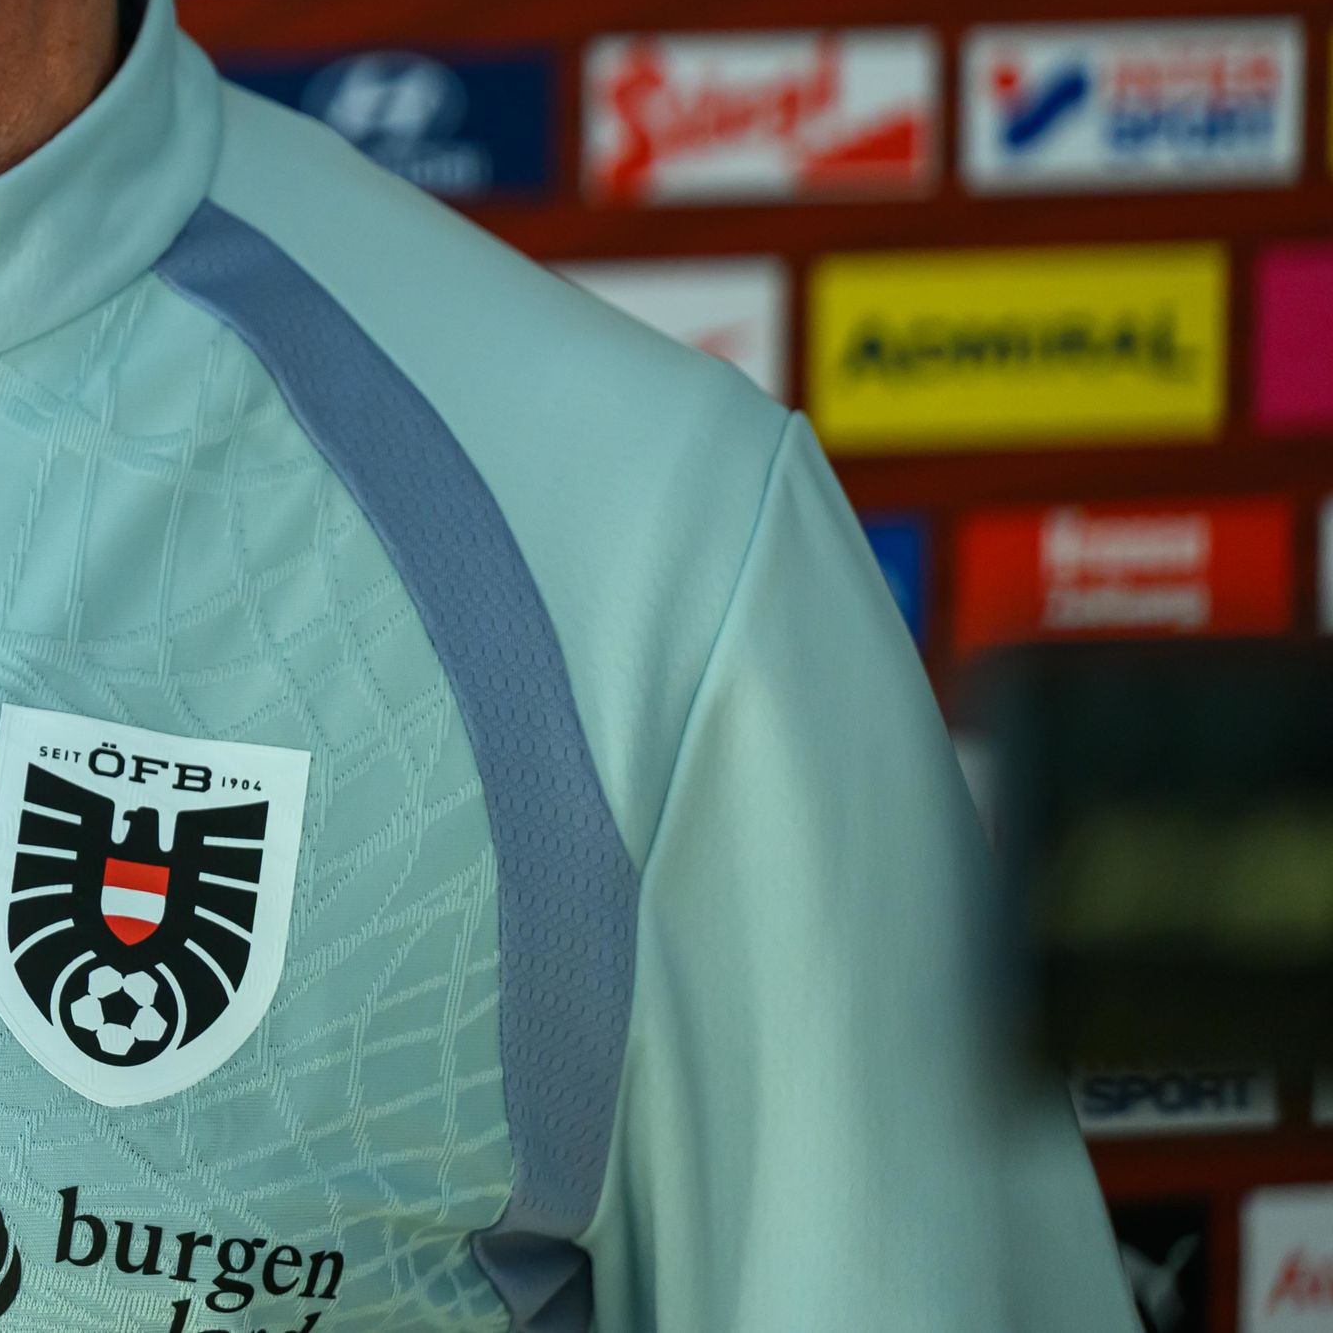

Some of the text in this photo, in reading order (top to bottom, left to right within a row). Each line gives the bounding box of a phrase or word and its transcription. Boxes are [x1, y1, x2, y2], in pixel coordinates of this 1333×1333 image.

[38, 741, 263, 793] SEIT ÖFB 1904
[54, 1184, 345, 1314] burgen
